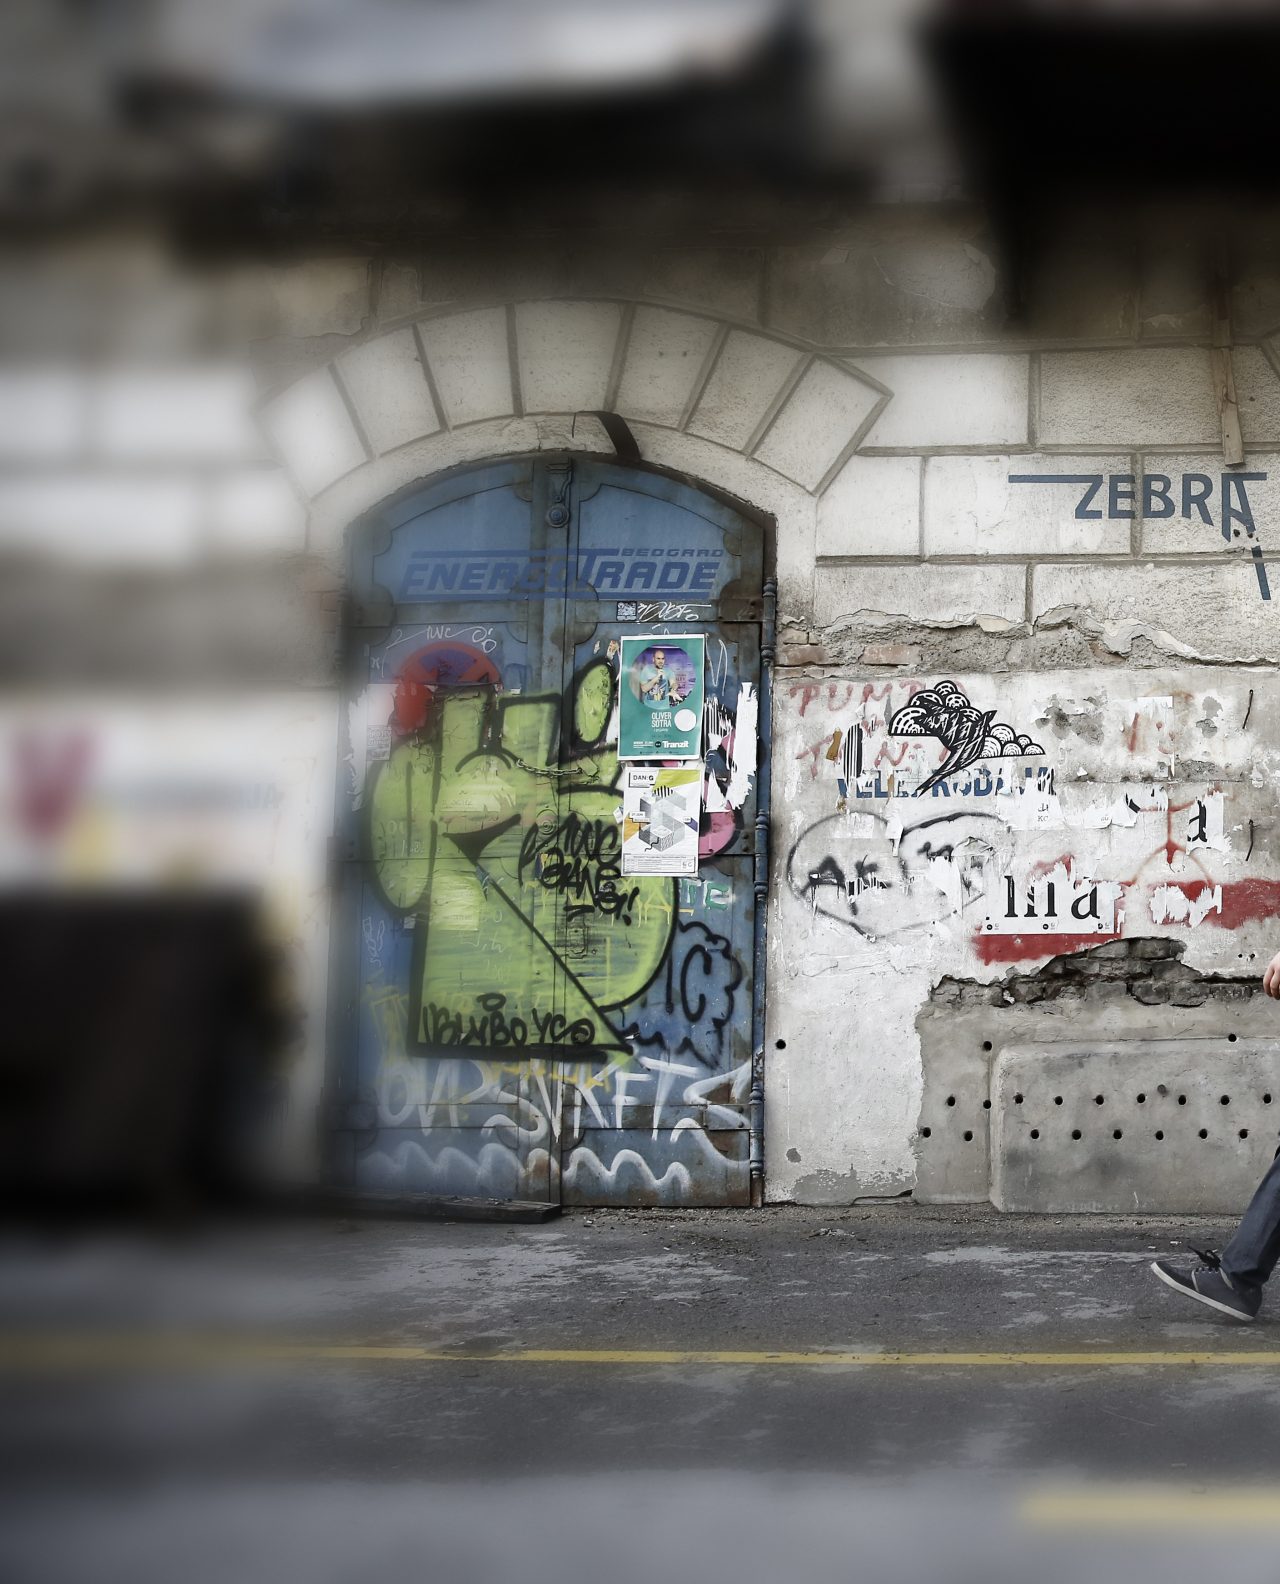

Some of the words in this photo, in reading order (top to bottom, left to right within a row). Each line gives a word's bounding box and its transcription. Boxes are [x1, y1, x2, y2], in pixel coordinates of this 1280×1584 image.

[1008, 472, 1266, 542] ZEBRA
[620, 548, 724, 557] BEOGRAD
[651, 712, 672, 720] OLIVER
[662, 740, 689, 748] Tranzit
